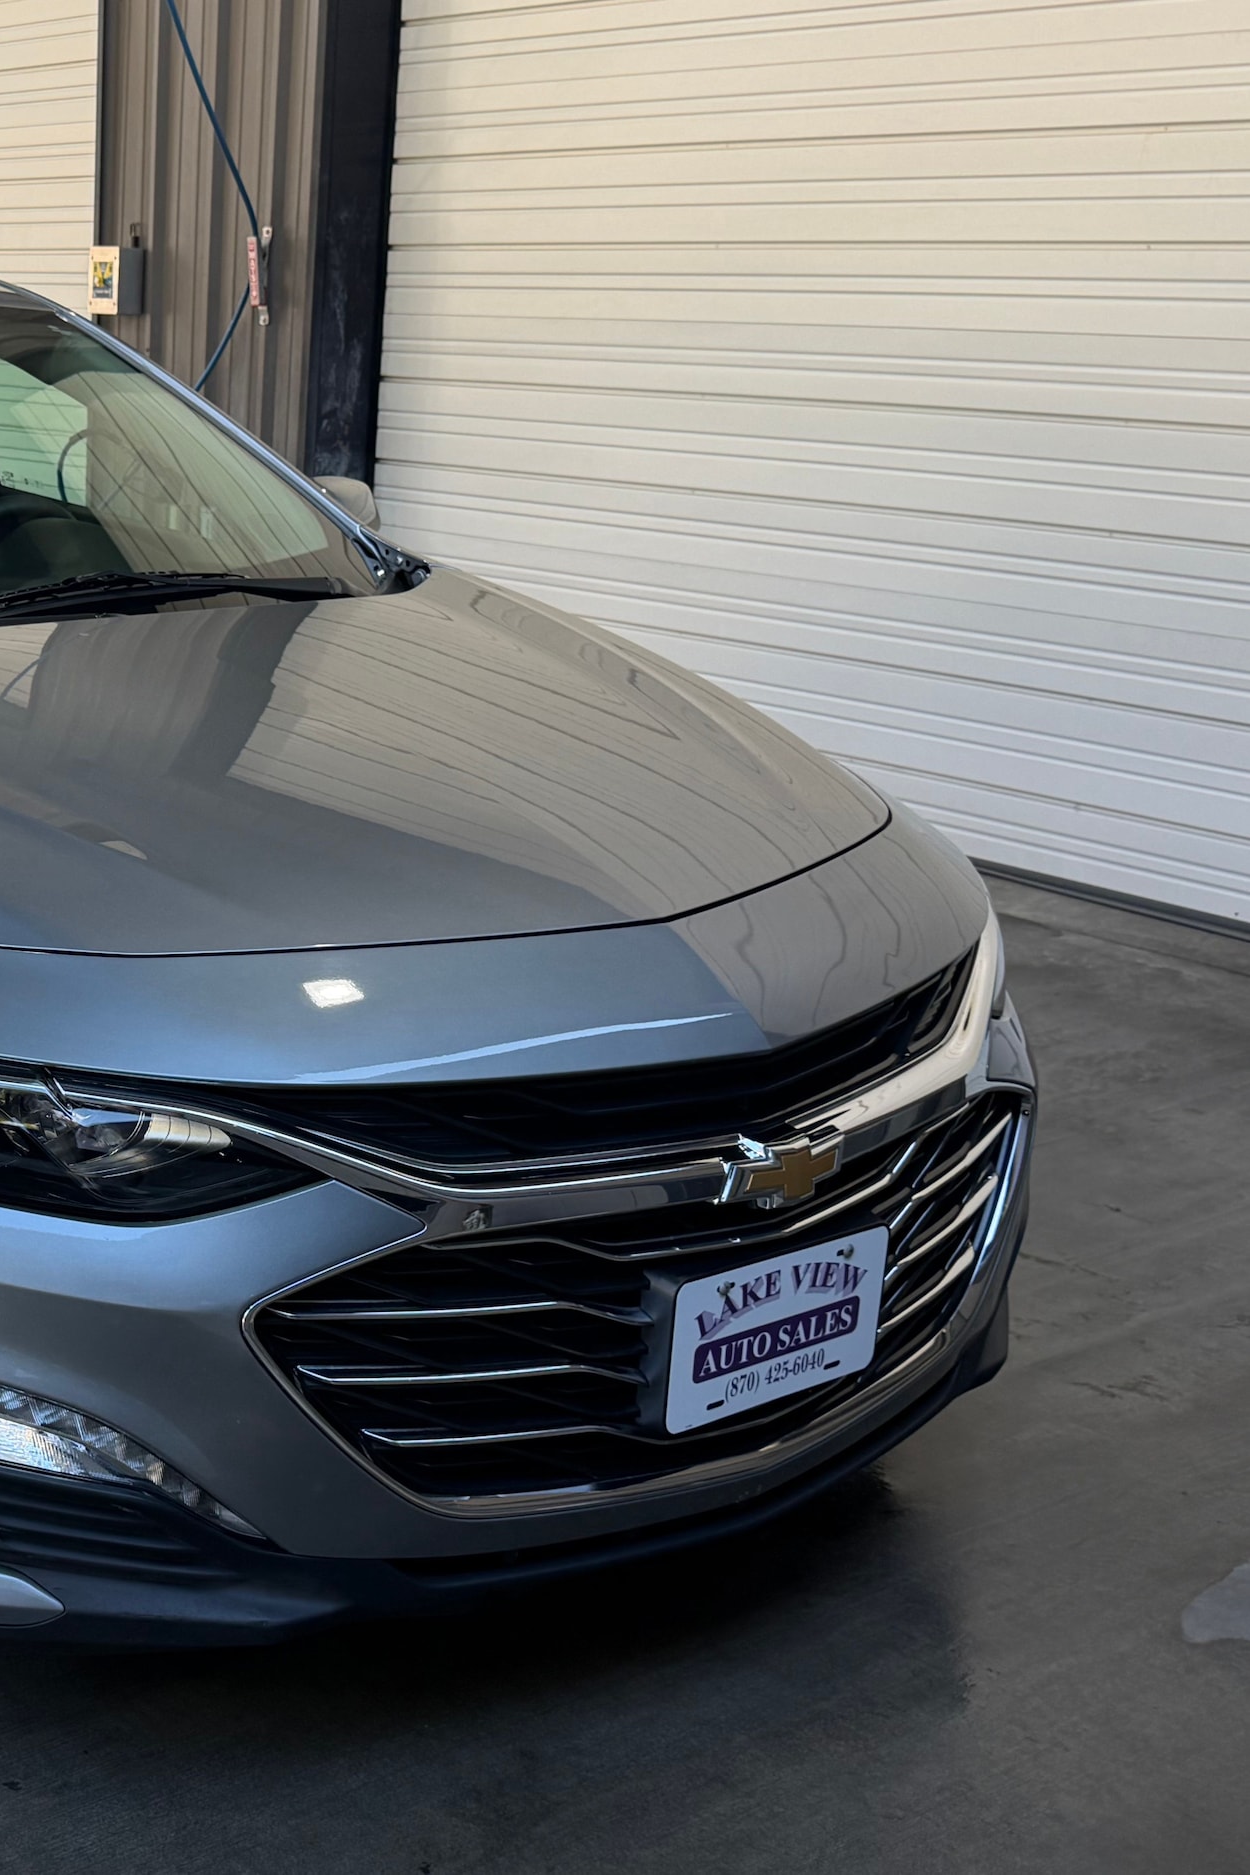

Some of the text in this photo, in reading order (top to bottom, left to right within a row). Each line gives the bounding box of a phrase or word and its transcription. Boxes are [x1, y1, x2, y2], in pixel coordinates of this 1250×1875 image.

[694, 1261, 868, 1340] LAKE VIEW
[699, 1304, 853, 1377] AUTO SALES
[724, 1348, 825, 1404] (870) 425-6040
